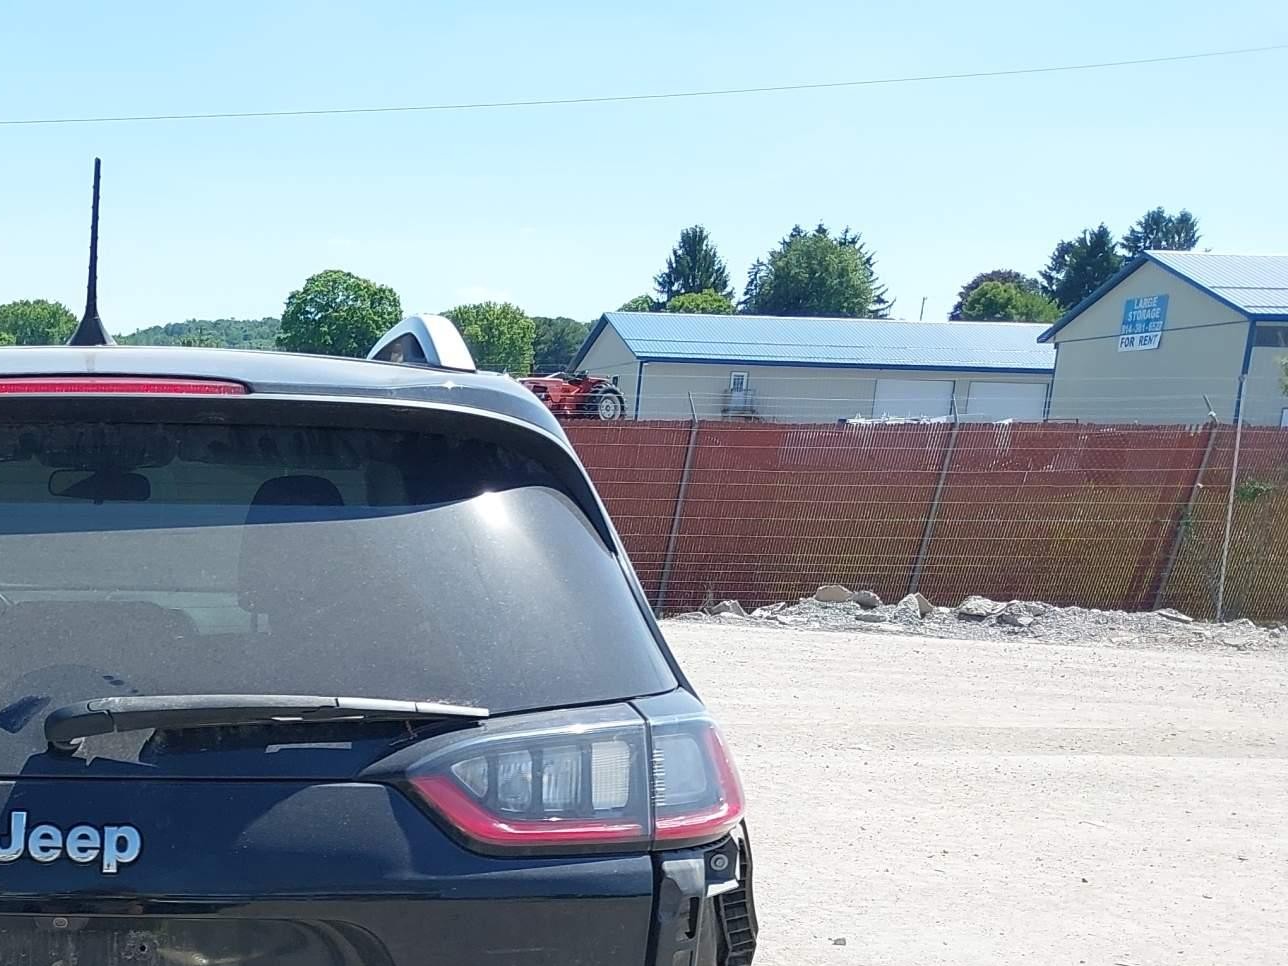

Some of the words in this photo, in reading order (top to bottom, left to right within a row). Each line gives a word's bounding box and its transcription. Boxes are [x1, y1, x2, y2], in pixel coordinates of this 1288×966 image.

[1134, 296, 1159, 309] LARGE
[1128, 307, 1161, 321] STORAGE
[1120, 336, 1135, 348] FOR
[1139, 334, 1159, 346] RENT
